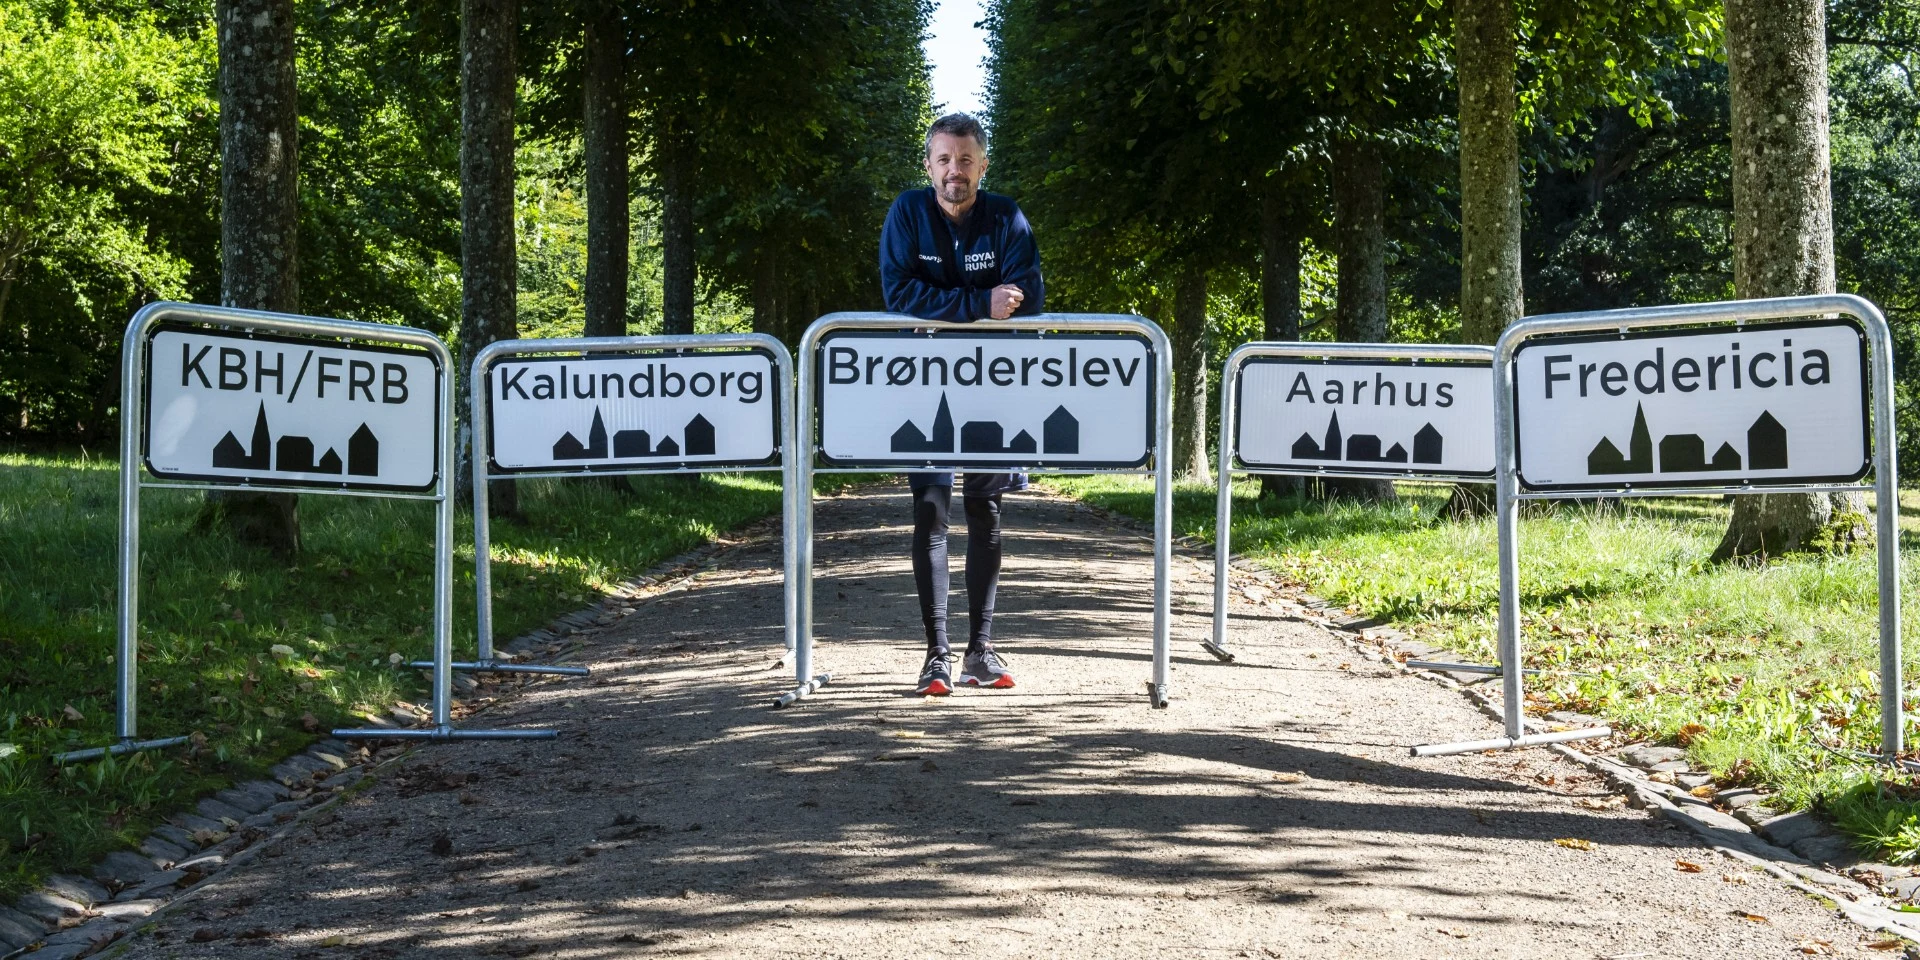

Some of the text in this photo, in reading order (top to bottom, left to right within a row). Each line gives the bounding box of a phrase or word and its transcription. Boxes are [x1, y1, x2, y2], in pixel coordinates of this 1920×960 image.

[965, 261, 987, 272] RUN
[181, 342, 409, 404] KBH/FRB
[501, 363, 763, 404] Kalundborg
[828, 346, 1141, 387] Brønderslev
[1544, 338, 1831, 399] Fredericia
[1285, 371, 1454, 408] Aarhus
